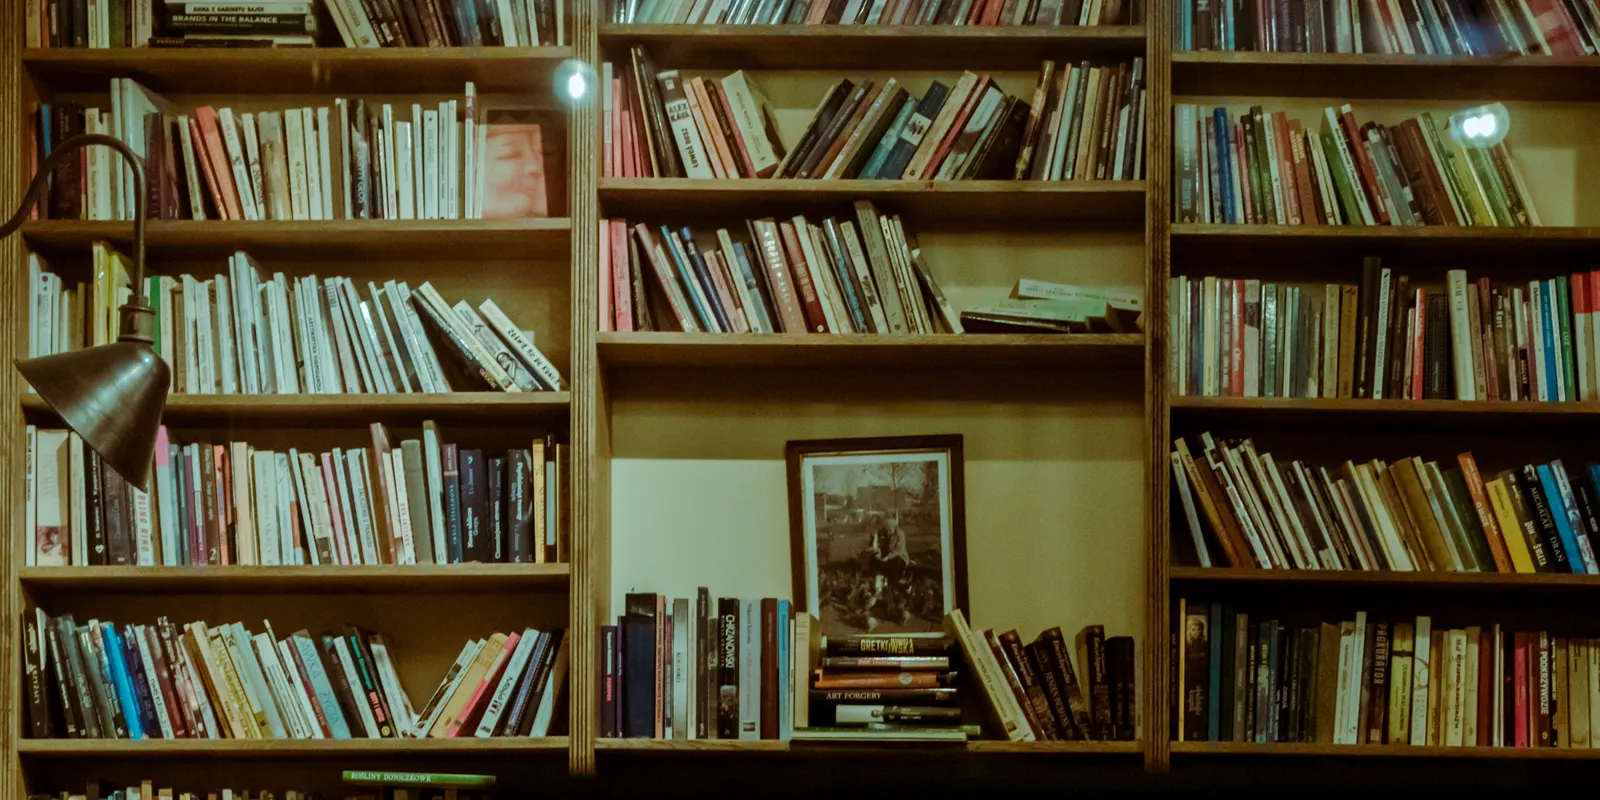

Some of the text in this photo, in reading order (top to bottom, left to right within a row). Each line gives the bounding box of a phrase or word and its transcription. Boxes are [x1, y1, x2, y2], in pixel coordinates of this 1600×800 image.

[172, 15, 207, 23] BRANDS
[238, 16, 278, 24] BALANCE
[1495, 310, 1504, 328] Kerr
[136, 494, 150, 552] BLING RING
[1529, 486, 1566, 563] MICHALAK DRAŃ
[724, 614, 735, 668] CHRZANOWSKI
[860, 637, 915, 654] GRETKOWSKA
[1372, 623, 1387, 685] PROKURATOR
[826, 692, 881, 700] ART FORGERY
[1539, 650, 1548, 714] PODKRZYWDZIE
[350, 770, 432, 783] ROŚLINY DONICZKOWE
